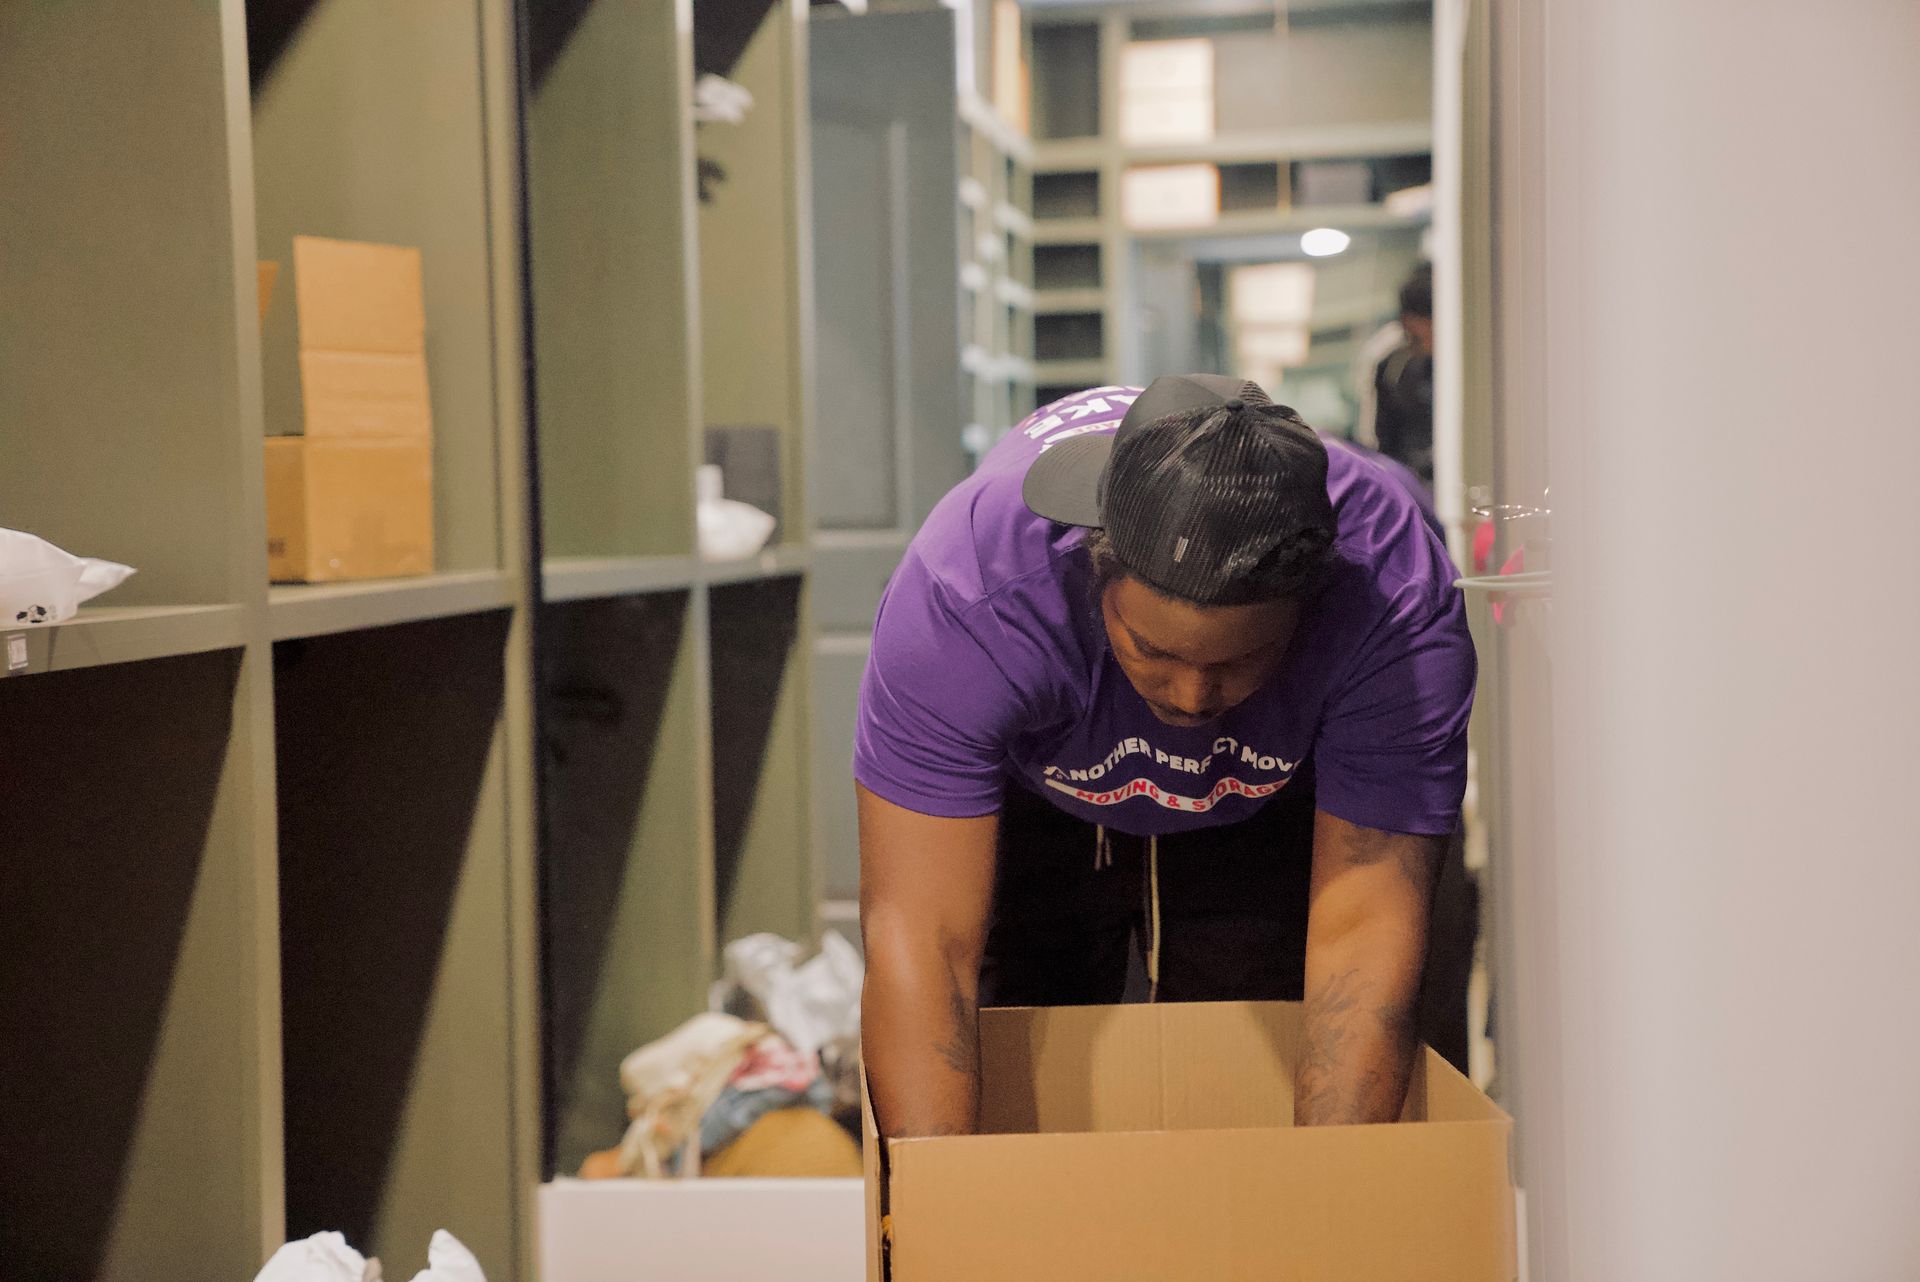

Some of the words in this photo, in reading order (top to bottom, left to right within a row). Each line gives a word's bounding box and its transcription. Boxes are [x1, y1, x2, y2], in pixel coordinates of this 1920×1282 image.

[1155, 737, 1238, 775] PERFCT
[1240, 745, 1301, 772] MOV
[1075, 780, 1160, 804] MOVING
[1166, 795, 1181, 808] &
